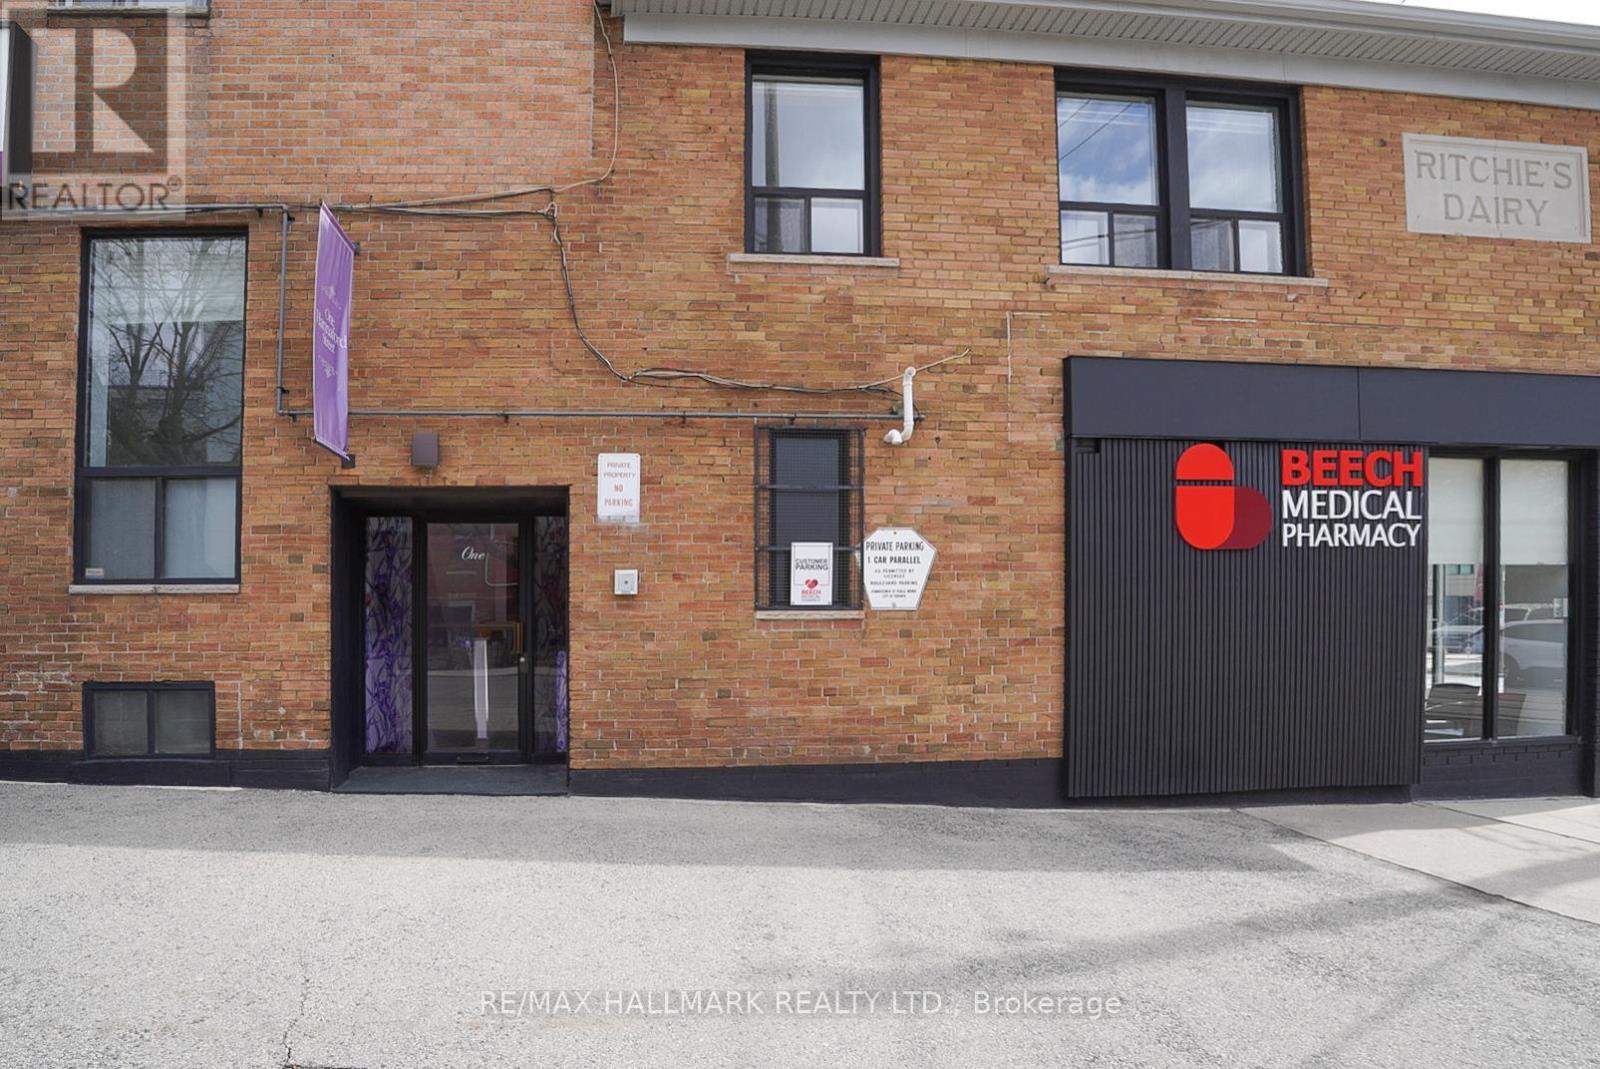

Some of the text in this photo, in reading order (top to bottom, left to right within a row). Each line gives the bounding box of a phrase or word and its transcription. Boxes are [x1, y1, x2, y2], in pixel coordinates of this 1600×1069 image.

[1414, 150, 1572, 189] RITCHIE'S
[1443, 193, 1549, 226] DAIRY
[1281, 449, 1424, 487] BEECH
[614, 483, 624, 493] NO
[604, 498, 633, 507] PARKING
[1282, 489, 1422, 520] MEDICAL
[1282, 522, 1421, 547] PHARMACY
[461, 546, 486, 560] One
[865, 541, 925, 551] PRIVATE PARKING
[873, 556, 887, 564] CAR
[889, 556, 921, 564] PARALLEL
